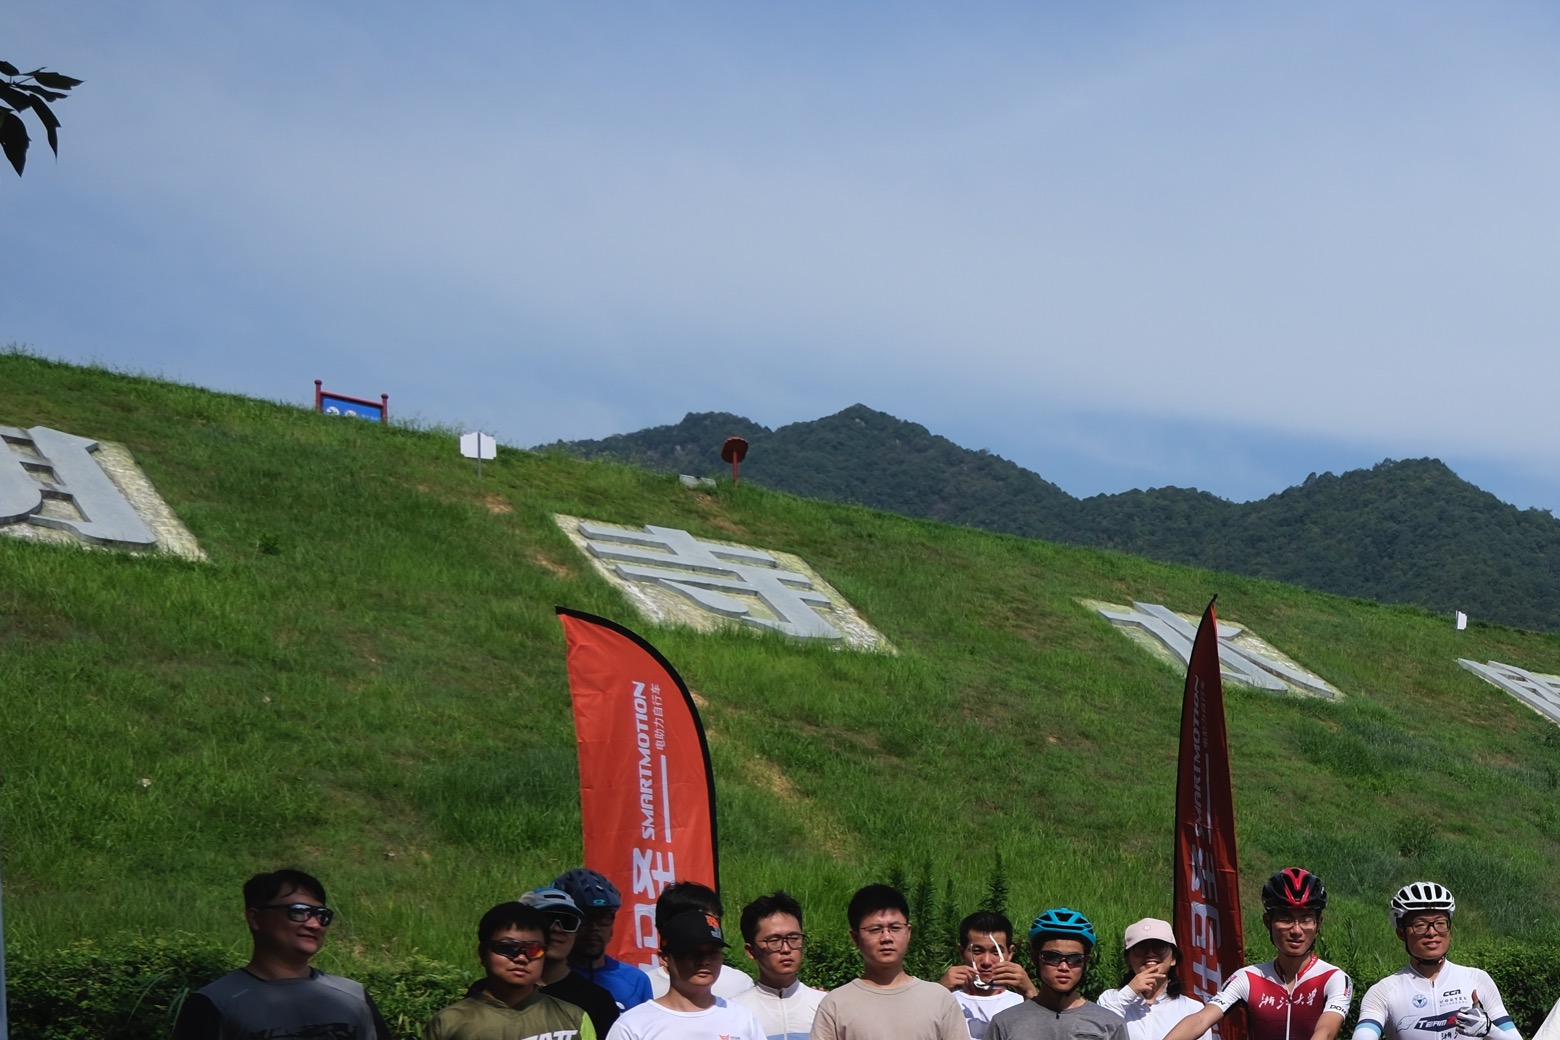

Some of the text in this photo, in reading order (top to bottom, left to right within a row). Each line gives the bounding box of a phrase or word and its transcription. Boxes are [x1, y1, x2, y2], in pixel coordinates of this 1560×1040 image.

[632, 680, 656, 840] SMARTMOTION
[650, 684, 667, 751] 电助力自行车
